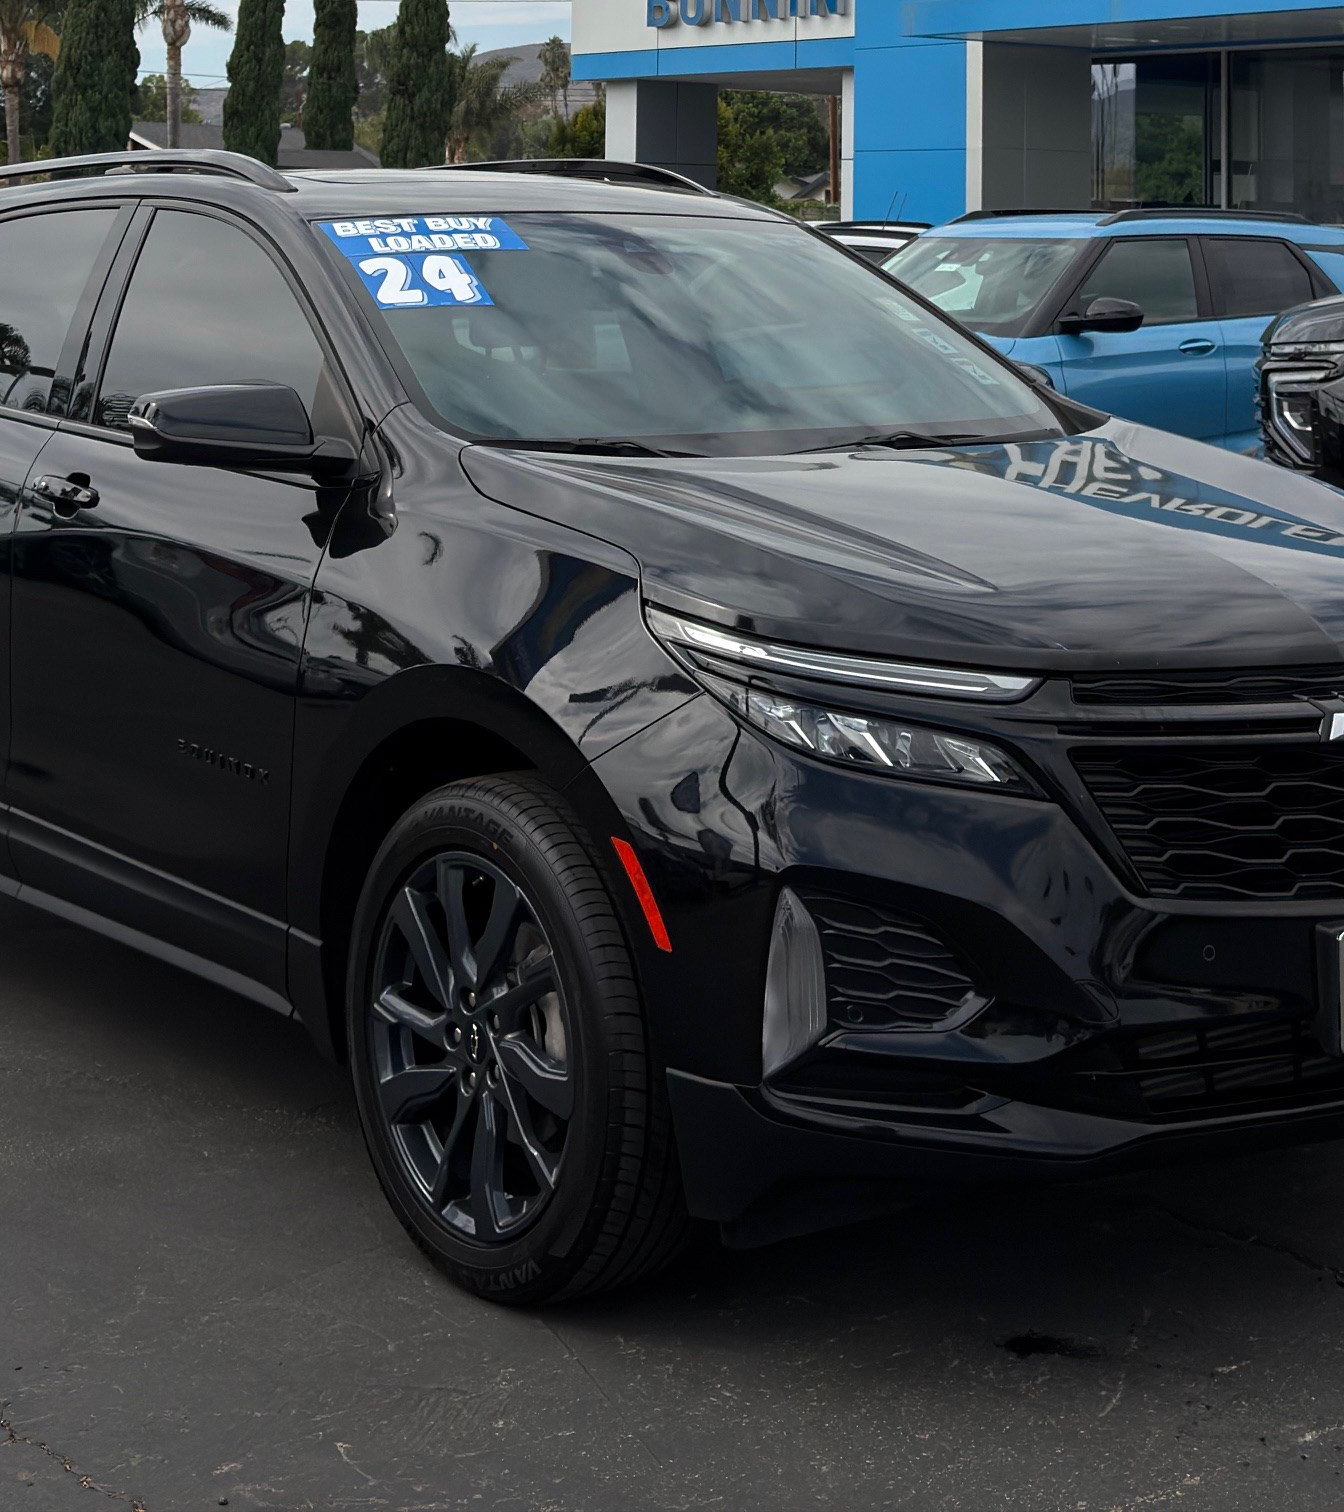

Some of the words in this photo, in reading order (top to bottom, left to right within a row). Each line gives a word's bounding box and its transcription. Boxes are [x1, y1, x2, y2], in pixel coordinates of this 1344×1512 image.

[333, 219, 417, 237] BEST
[424, 217, 493, 232] BUY
[367, 233, 500, 253] LOADED
[358, 255, 483, 306] 24
